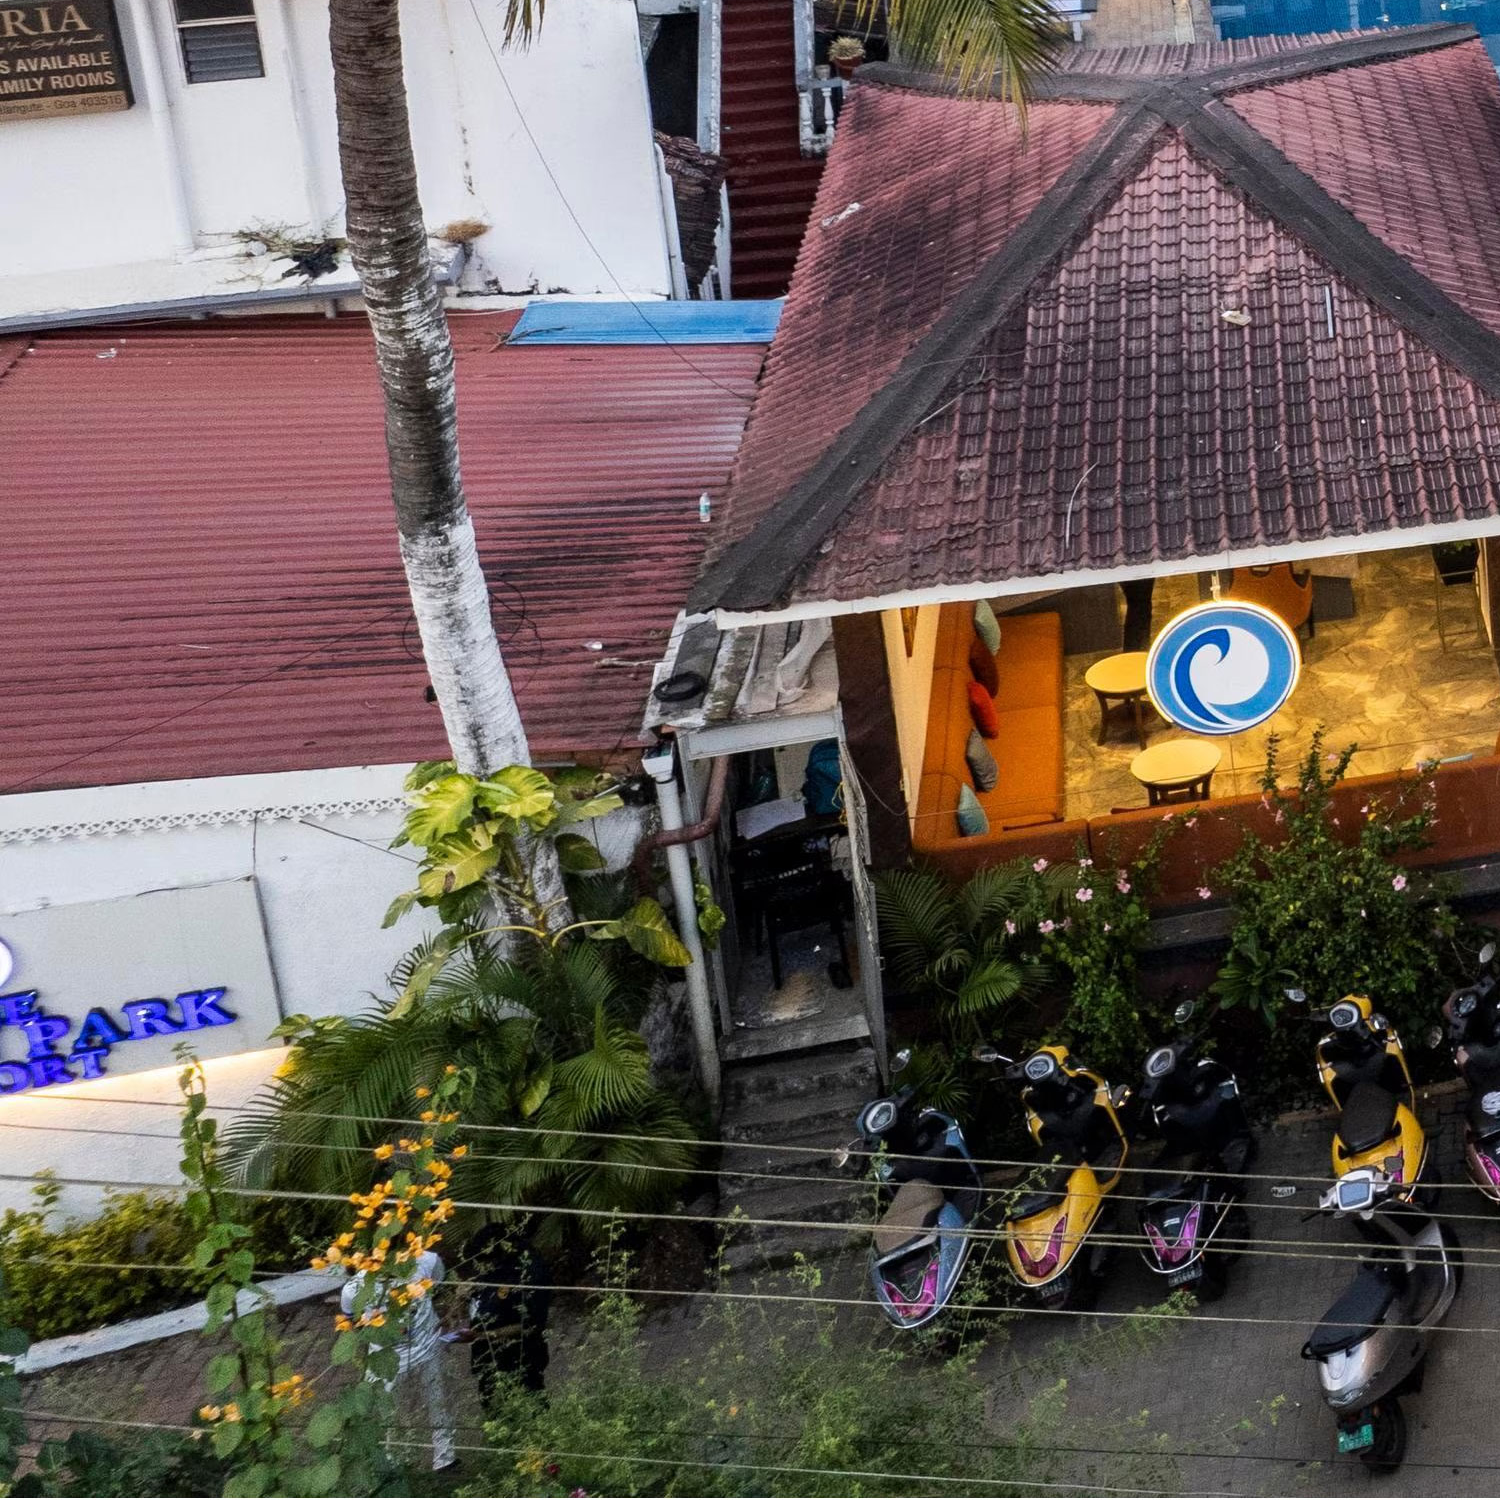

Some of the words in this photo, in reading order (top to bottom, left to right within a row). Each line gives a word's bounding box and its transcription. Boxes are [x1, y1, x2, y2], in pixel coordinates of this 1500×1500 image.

[15, 51, 112, 73] AVAILABLE
[50, 71, 116, 89] ROOMS
[22, 987, 237, 1058] PARK
